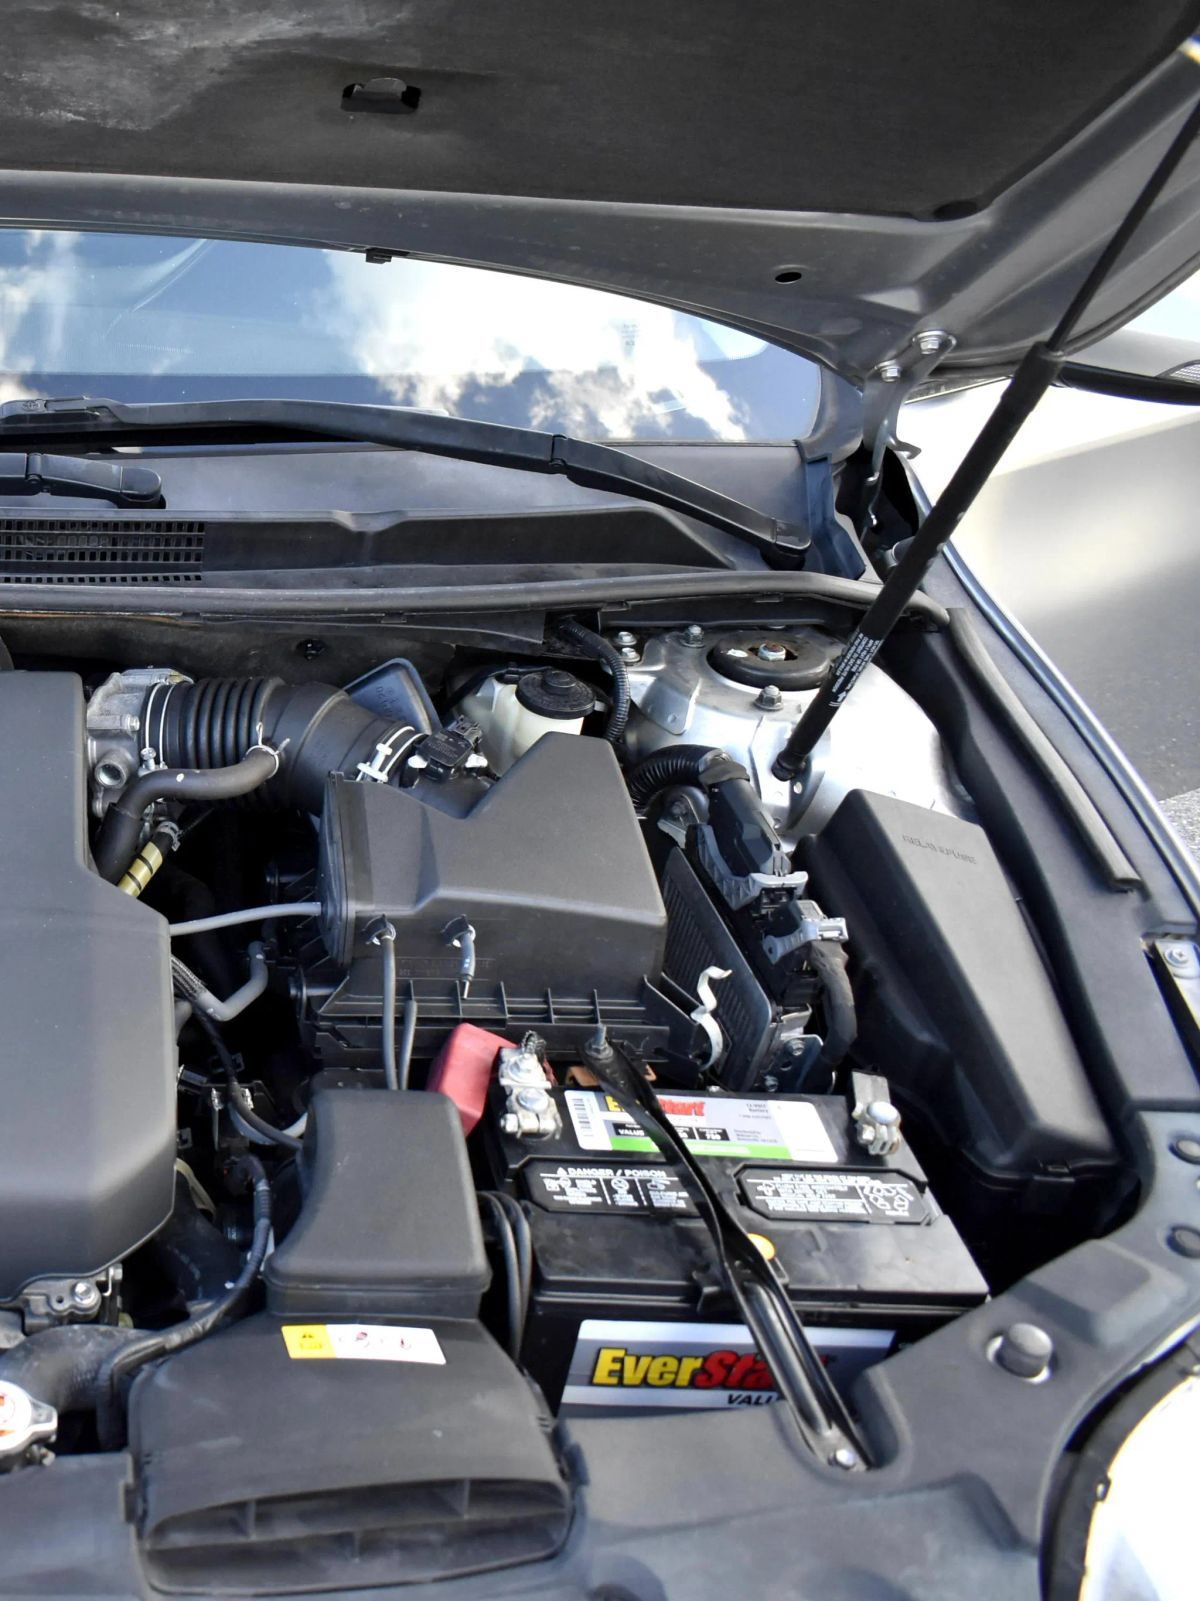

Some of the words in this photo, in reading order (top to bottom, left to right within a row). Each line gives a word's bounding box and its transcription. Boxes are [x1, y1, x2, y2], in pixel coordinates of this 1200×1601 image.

[567, 1167, 613, 1177] DANGER
[624, 1169, 667, 1178] POISON
[591, 1347, 828, 1390] EverSta
